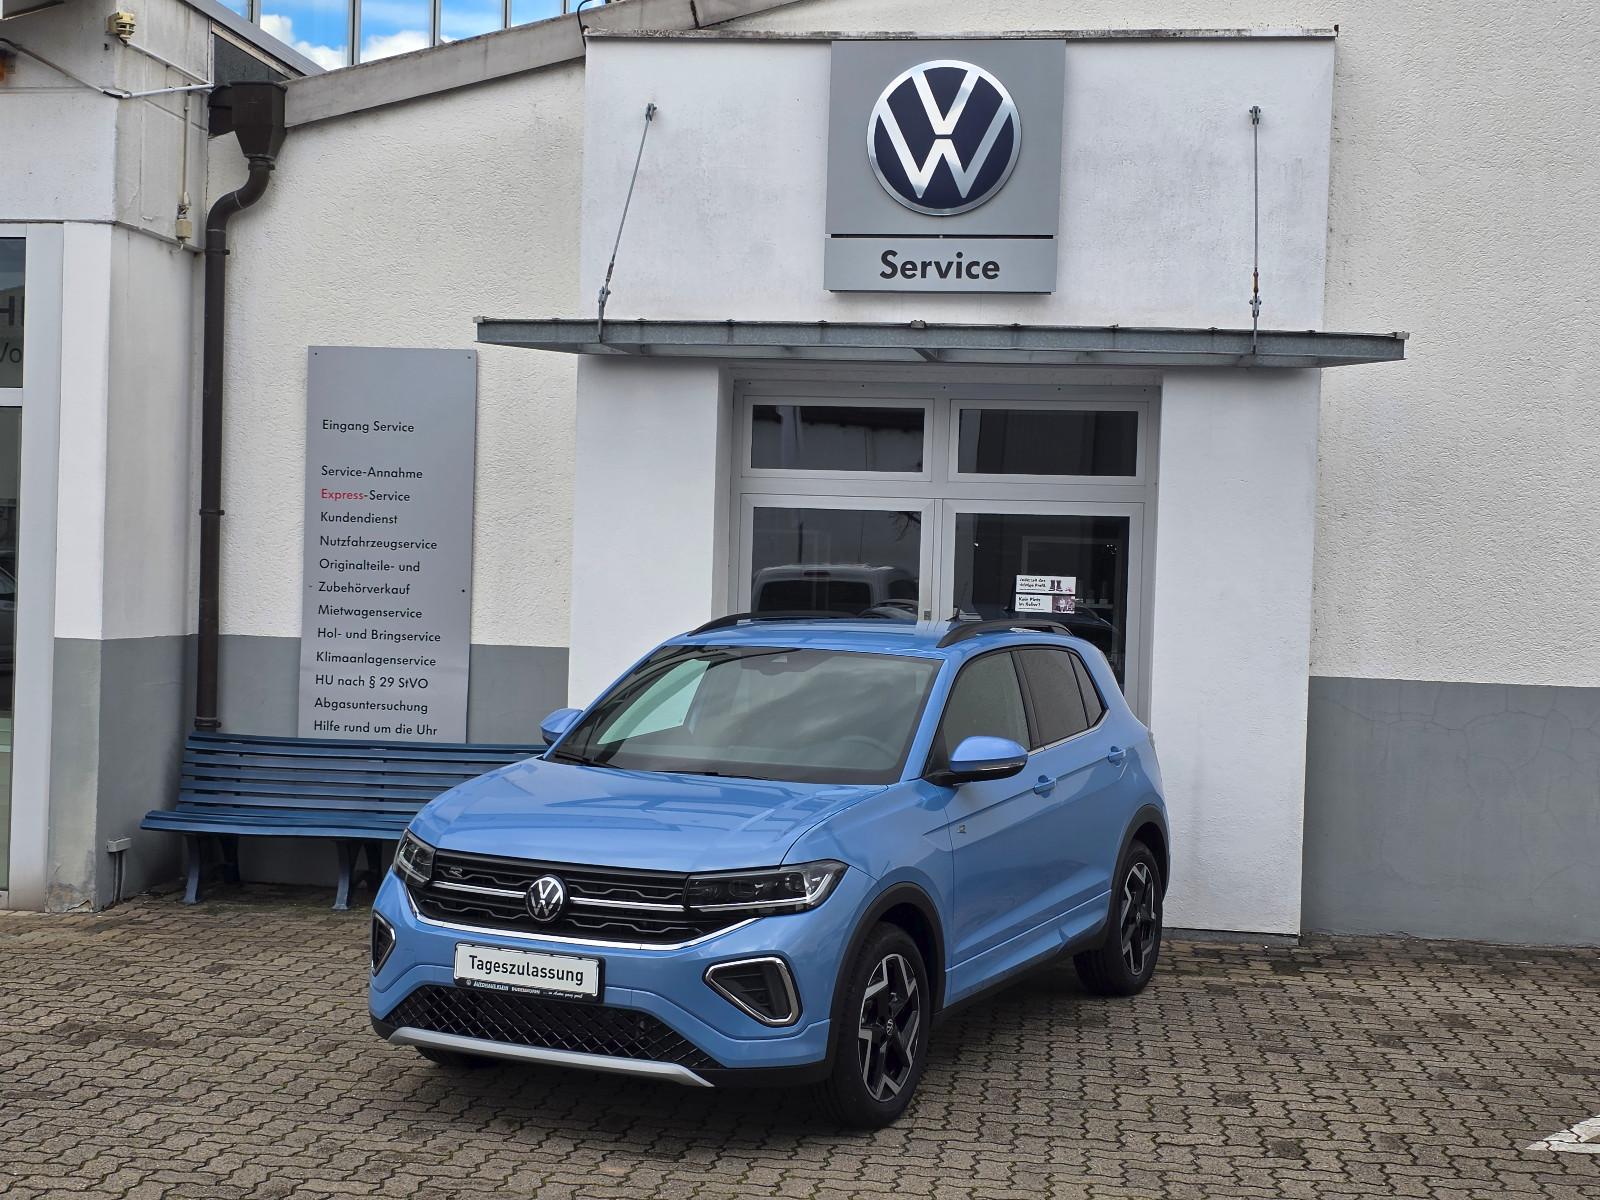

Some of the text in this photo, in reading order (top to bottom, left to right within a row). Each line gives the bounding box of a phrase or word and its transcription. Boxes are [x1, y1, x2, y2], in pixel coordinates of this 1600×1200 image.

[880, 250, 1000, 280] Service
[322, 419, 415, 433] Eingang Service
[321, 465, 423, 479] Service-Annahme
[321, 488, 410, 501] Express-Service
[320, 512, 398, 524] Kundendienst
[320, 535, 438, 551] Nutzfahrzeugservice
[319, 558, 420, 573] Originalteile- und
[318, 581, 410, 595] Zubehörverkauf
[317, 604, 423, 619] Mietwagenservice
[317, 627, 441, 643] Hol- und Bringservice
[316, 651, 436, 667] Klimaanlagenservice
[315, 674, 429, 689] HU nach § 29 StVO
[314, 697, 428, 714] Abgasuntersuchung
[313, 720, 438, 736] Hilfe rund um die Uhr
[468, 954, 584, 986] Tageszulassung
